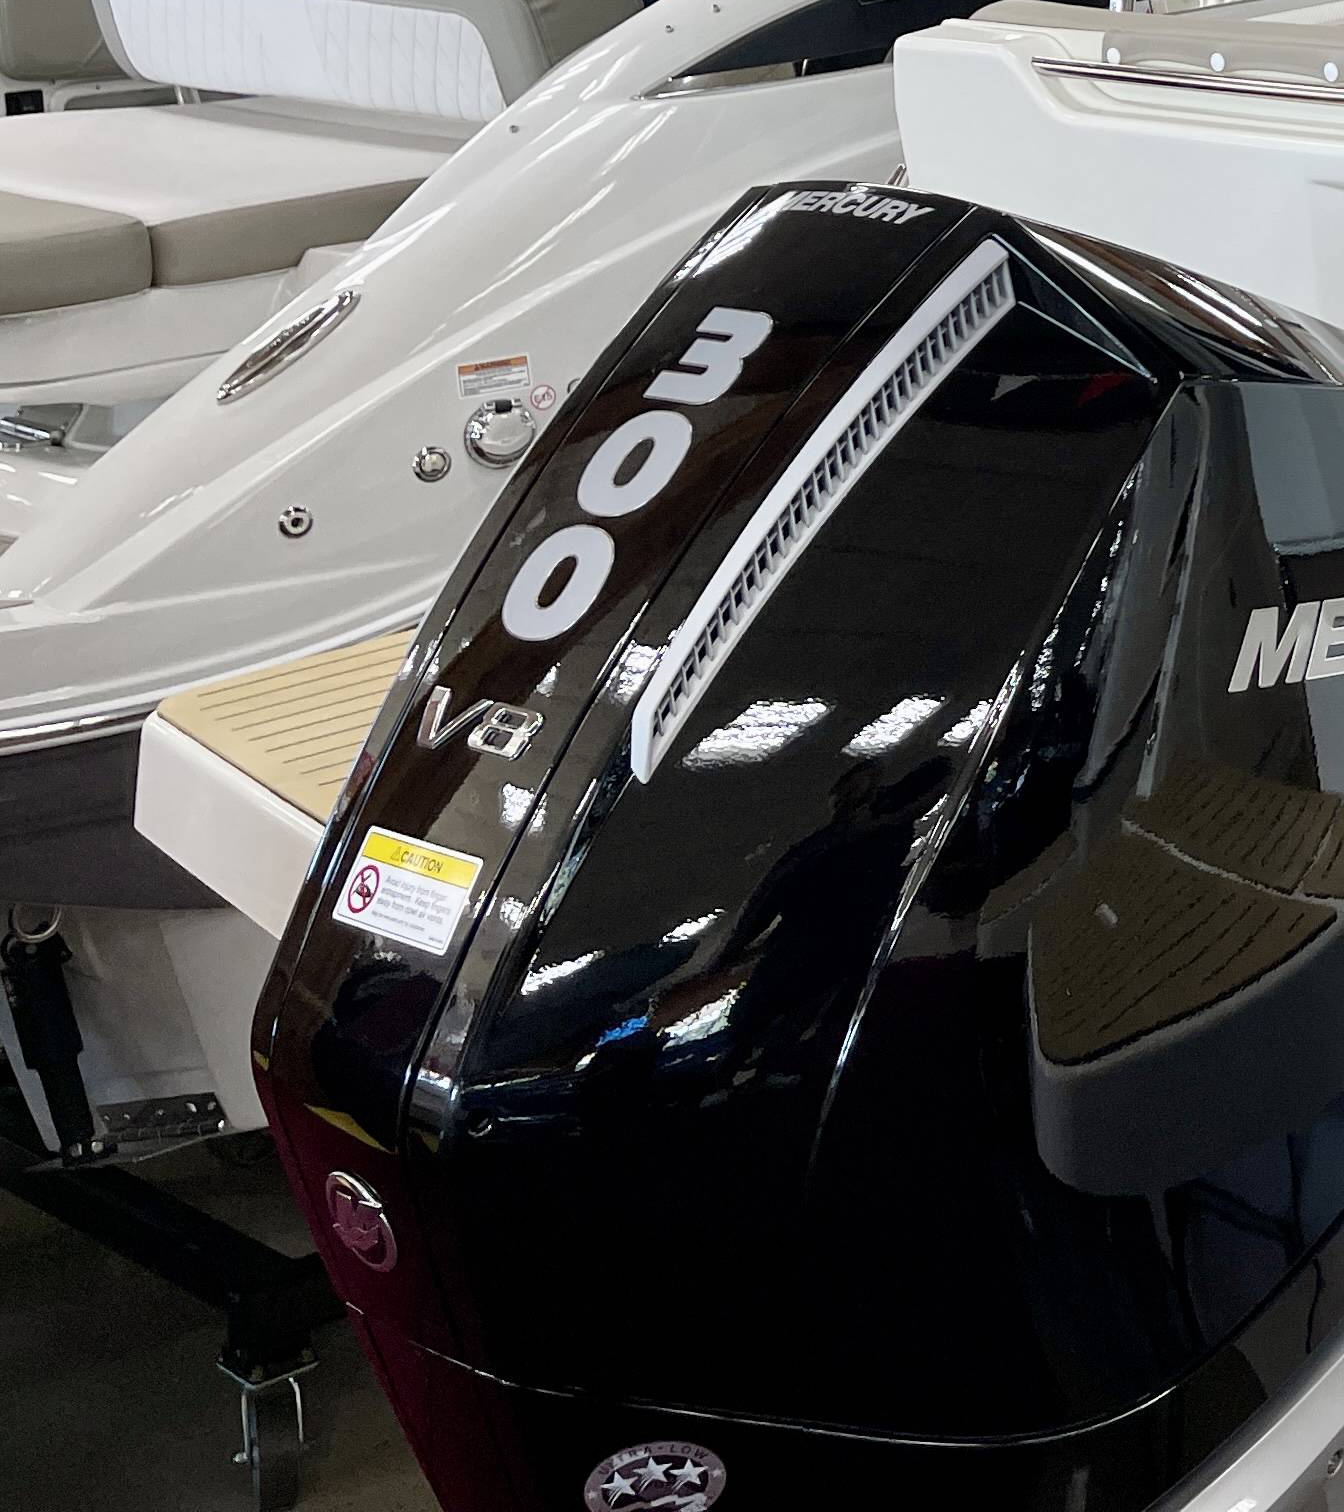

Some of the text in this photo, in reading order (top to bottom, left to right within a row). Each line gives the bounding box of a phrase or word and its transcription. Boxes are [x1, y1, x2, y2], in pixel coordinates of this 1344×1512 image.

[776, 190, 935, 225] MERCURY
[501, 306, 774, 642] 300
[416, 686, 545, 761] V8
[400, 850, 444, 874] CAUTION
